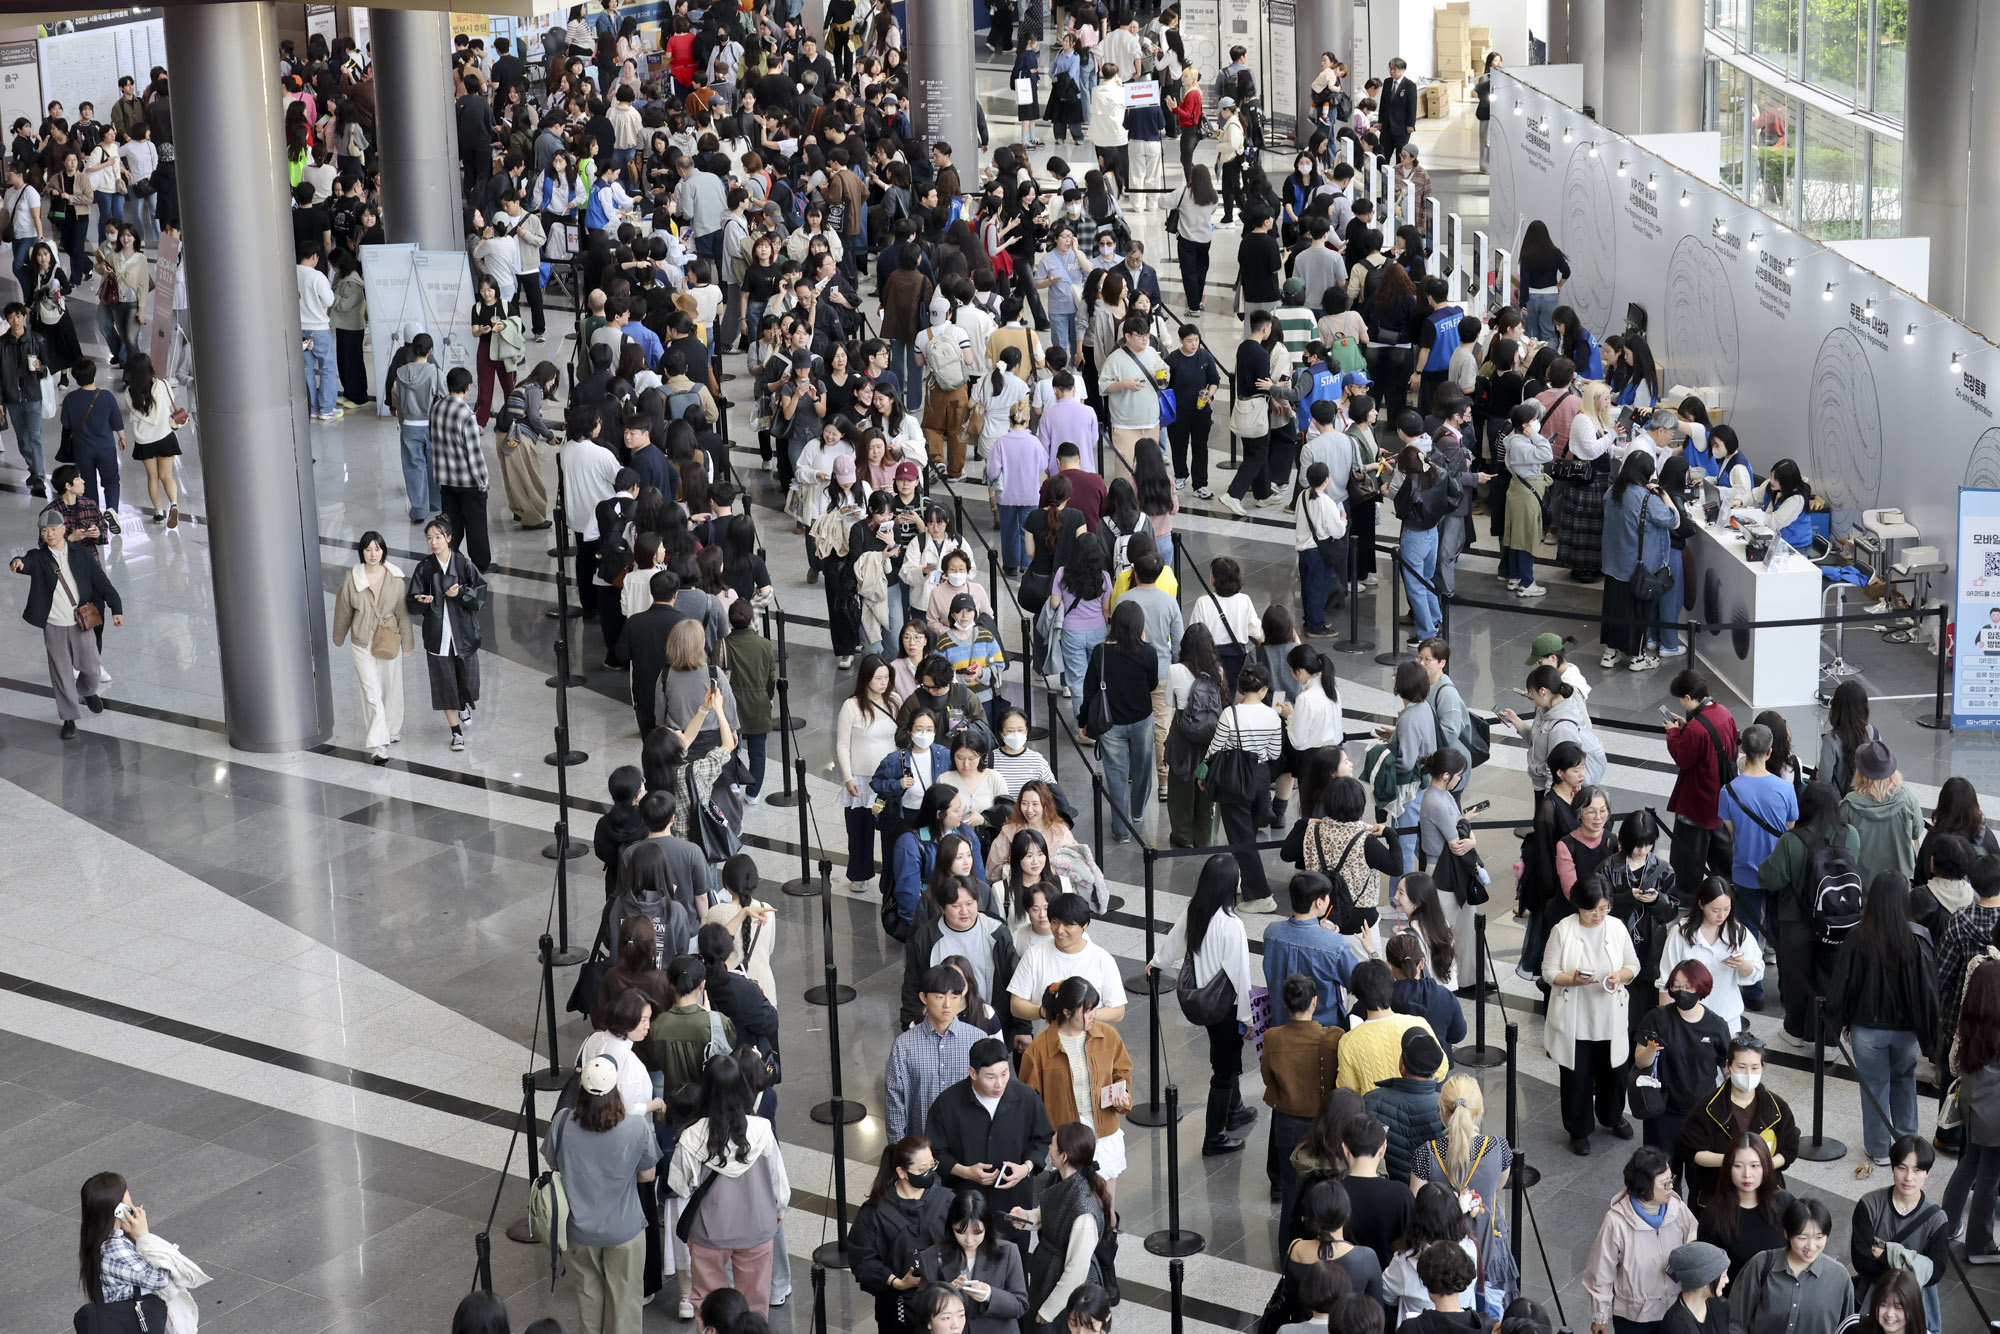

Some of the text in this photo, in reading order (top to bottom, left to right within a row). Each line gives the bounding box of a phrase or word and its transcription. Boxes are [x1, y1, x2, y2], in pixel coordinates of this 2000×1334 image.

[1638, 182, 1644, 195] QR
[1760, 250, 1768, 266] QR
[1440, 316, 1461, 333] STAFF
[1867, 330, 1889, 352] Registration
[1963, 371, 1986, 399] 현장등록
[1956, 387, 1993, 419] On-site Registration
